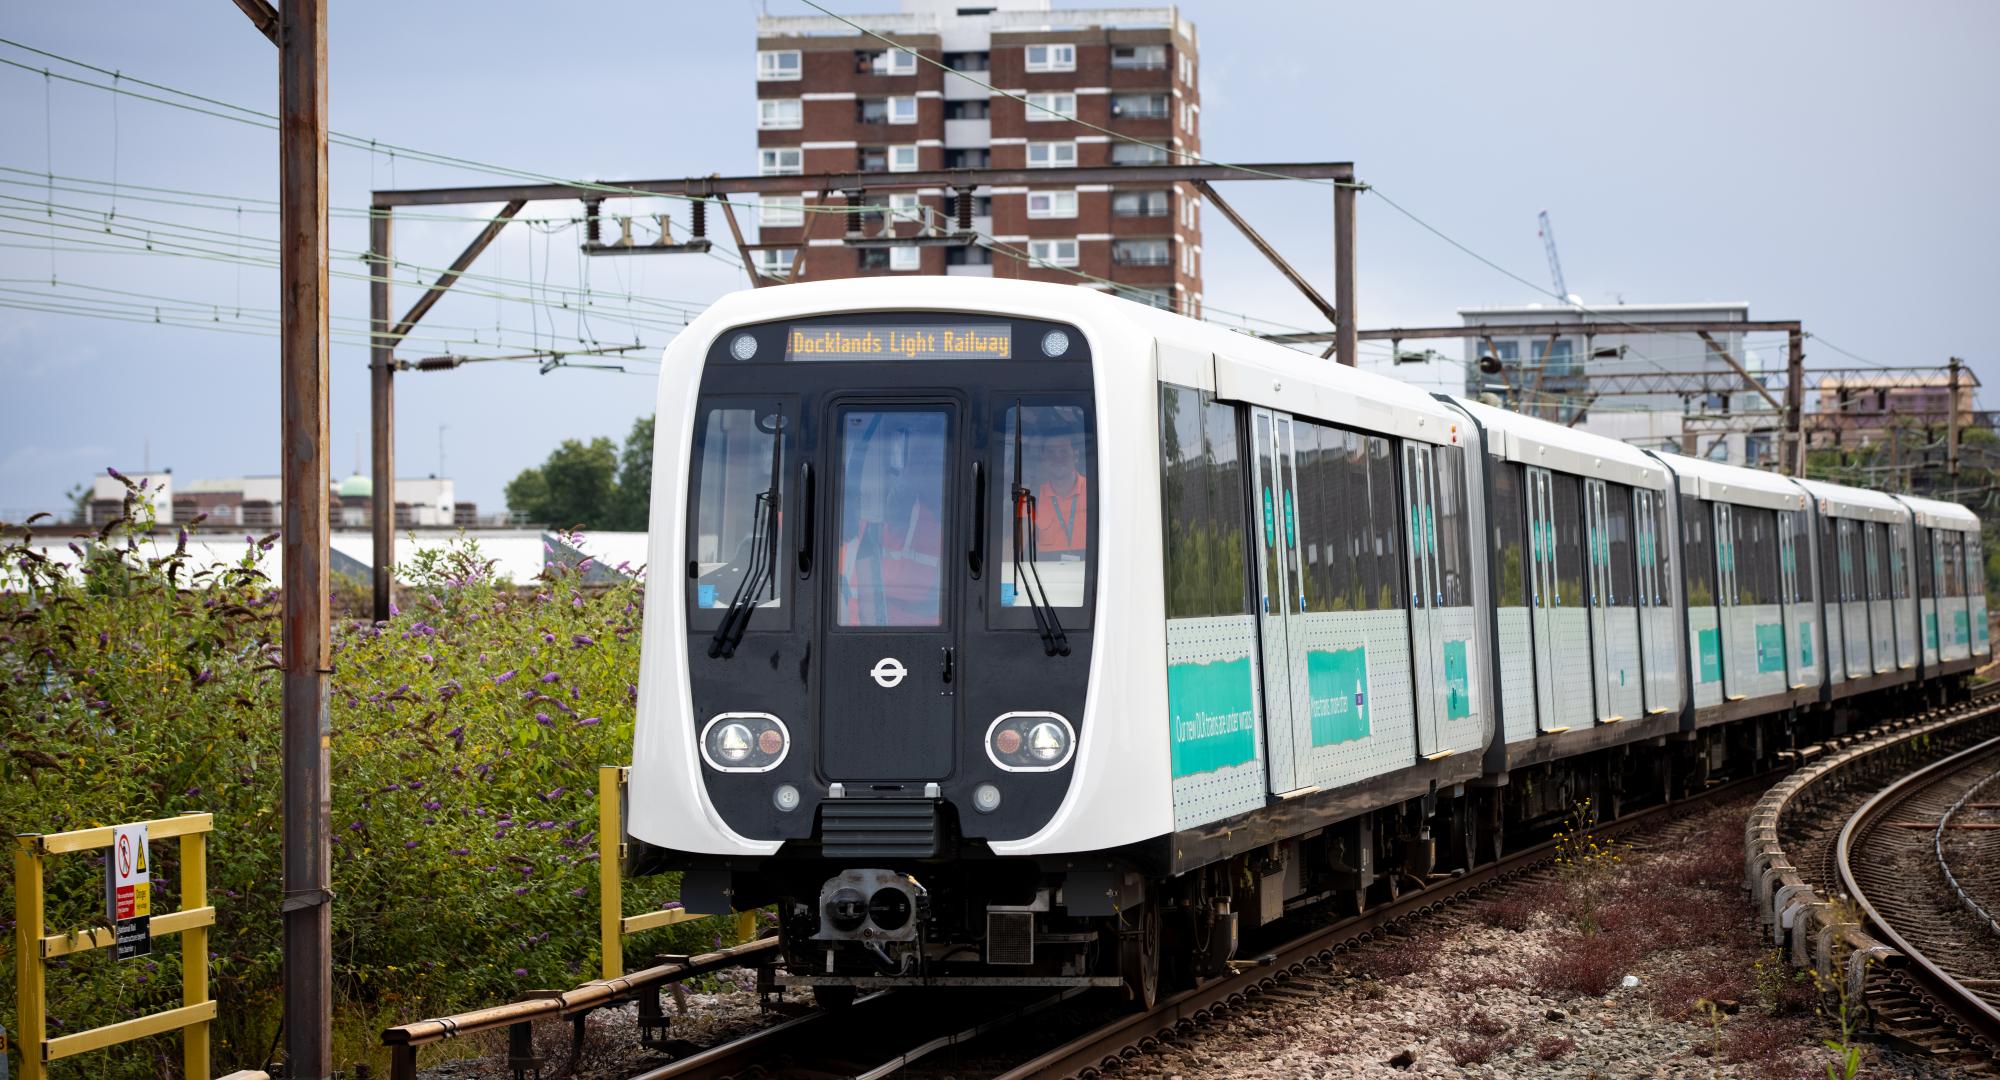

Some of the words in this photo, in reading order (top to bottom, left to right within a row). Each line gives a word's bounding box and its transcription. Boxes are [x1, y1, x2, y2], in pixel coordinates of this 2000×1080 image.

[793, 331, 882, 353] Docklands
[889, 331, 934, 358] Light
[944, 330, 1009, 357] Railway
[1176, 715, 1185, 743] Our
[1186, 720, 1196, 741] new
[1196, 711, 1206, 739] DLR
[1206, 712, 1219, 737] trains
